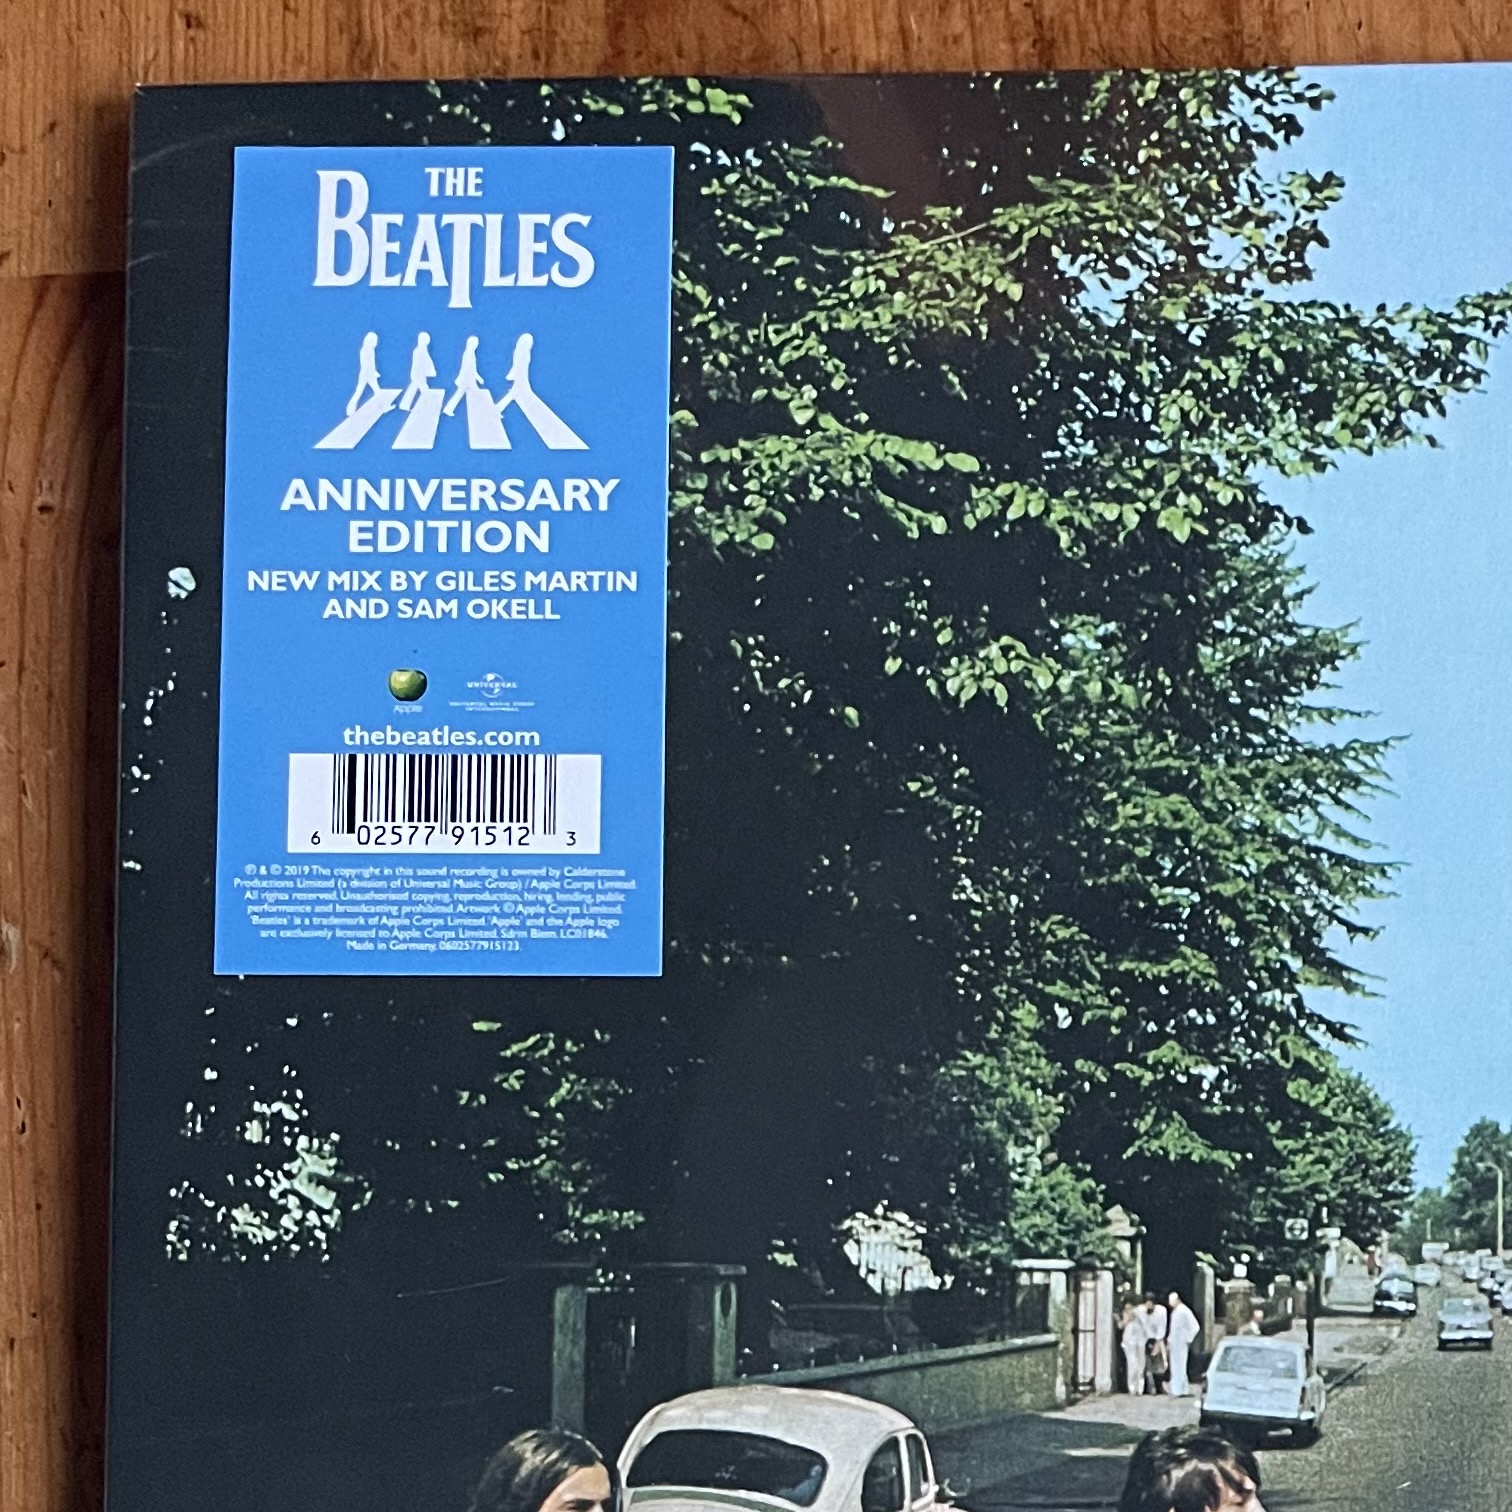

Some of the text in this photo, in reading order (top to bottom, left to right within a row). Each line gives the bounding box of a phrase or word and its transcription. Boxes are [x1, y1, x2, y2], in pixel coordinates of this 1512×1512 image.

[425, 168, 483, 196] THE
[313, 170, 594, 308] BEATLES
[281, 479, 619, 511] ANNIVERSARY
[349, 521, 549, 552] EDITION
[248, 571, 636, 591] NEW MIX BY GILES MARTIN
[323, 598, 560, 619] AND SAM OKELL
[344, 725, 539, 745] thebeatles.com
[310, 825, 577, 846] 6 02577 91512 3
[284, 865, 310, 875] 2019
[310, 865, 331, 875] The
[333, 865, 382, 878] copyright
[383, 865, 393, 876] in
[395, 865, 414, 876] this
[416, 865, 447, 876] sound
[450, 866, 499, 879] recording
[500, 866, 509, 876] is
[511, 866, 547, 876] owned
[548, 866, 561, 879] by
[233, 878, 294, 888] Productions
[297, 878, 335, 888] Limited
[350, 878, 388, 888] division
[390, 878, 401, 888] of
[403, 878, 451, 888] Universal
[453, 879, 482, 888] Music
[530, 879, 561, 891] Apple
[563, 879, 595, 891] Corps
[244, 890, 259, 900] All
[261, 890, 289, 903] rights
[595, 892, 626, 904] public
[247, 903, 312, 915] performance
[314, 903, 333, 913] and
[336, 903, 399, 916] broadcasting
[456, 904, 501, 913] Artwork
[548, 904, 580, 916] Corps
[293, 915, 302, 925] is
[312, 915, 365, 925] trademark
[368, 916, 379, 925] of
[379, 916, 410, 928] Apple
[412, 916, 445, 928] Corps
[525, 916, 544, 926] and
[546, 916, 564, 926] the
[565, 916, 595, 928] Apple
[597, 917, 620, 928] logo
[279, 928, 333, 940] exclusively
[336, 928, 376, 938] licensed
[378, 928, 390, 938] to
[391, 928, 422, 940] Apple
[424, 928, 455, 941] Corps
[346, 940, 375, 950] Made
[377, 940, 388, 950] in
